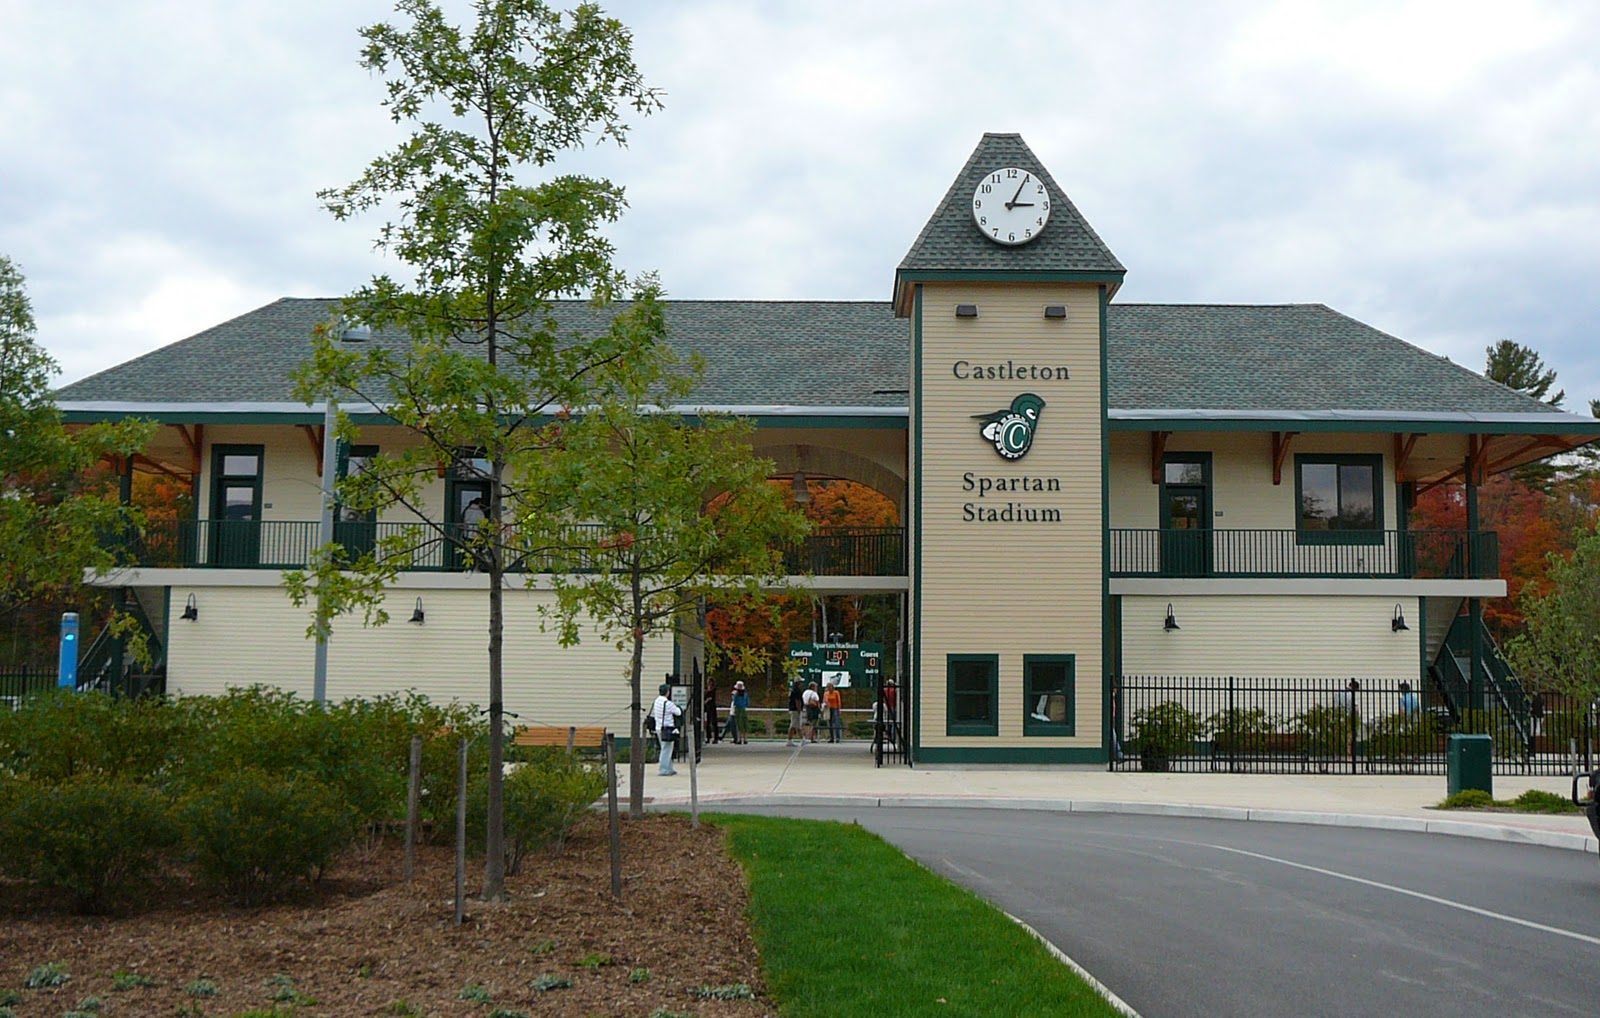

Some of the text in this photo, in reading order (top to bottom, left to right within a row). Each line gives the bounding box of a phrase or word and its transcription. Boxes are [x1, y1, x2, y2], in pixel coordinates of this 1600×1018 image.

[1007, 169, 1017, 178] 12
[992, 174, 1001, 183] 11
[981, 185, 992, 193] 10
[1037, 185, 1043, 194] 2
[975, 200, 981, 209] 9
[1042, 201, 1049, 210] 3
[980, 216, 987, 225] 8
[1036, 217, 1043, 226] 4
[992, 228, 999, 237] 7
[1008, 233, 1015, 241] 6
[1025, 229, 1031, 238] 5
[953, 360, 1070, 380] Castleton
[1009, 424, 1026, 449] C
[962, 472, 1061, 497] Spartan
[962, 503, 1062, 522] Stadium
